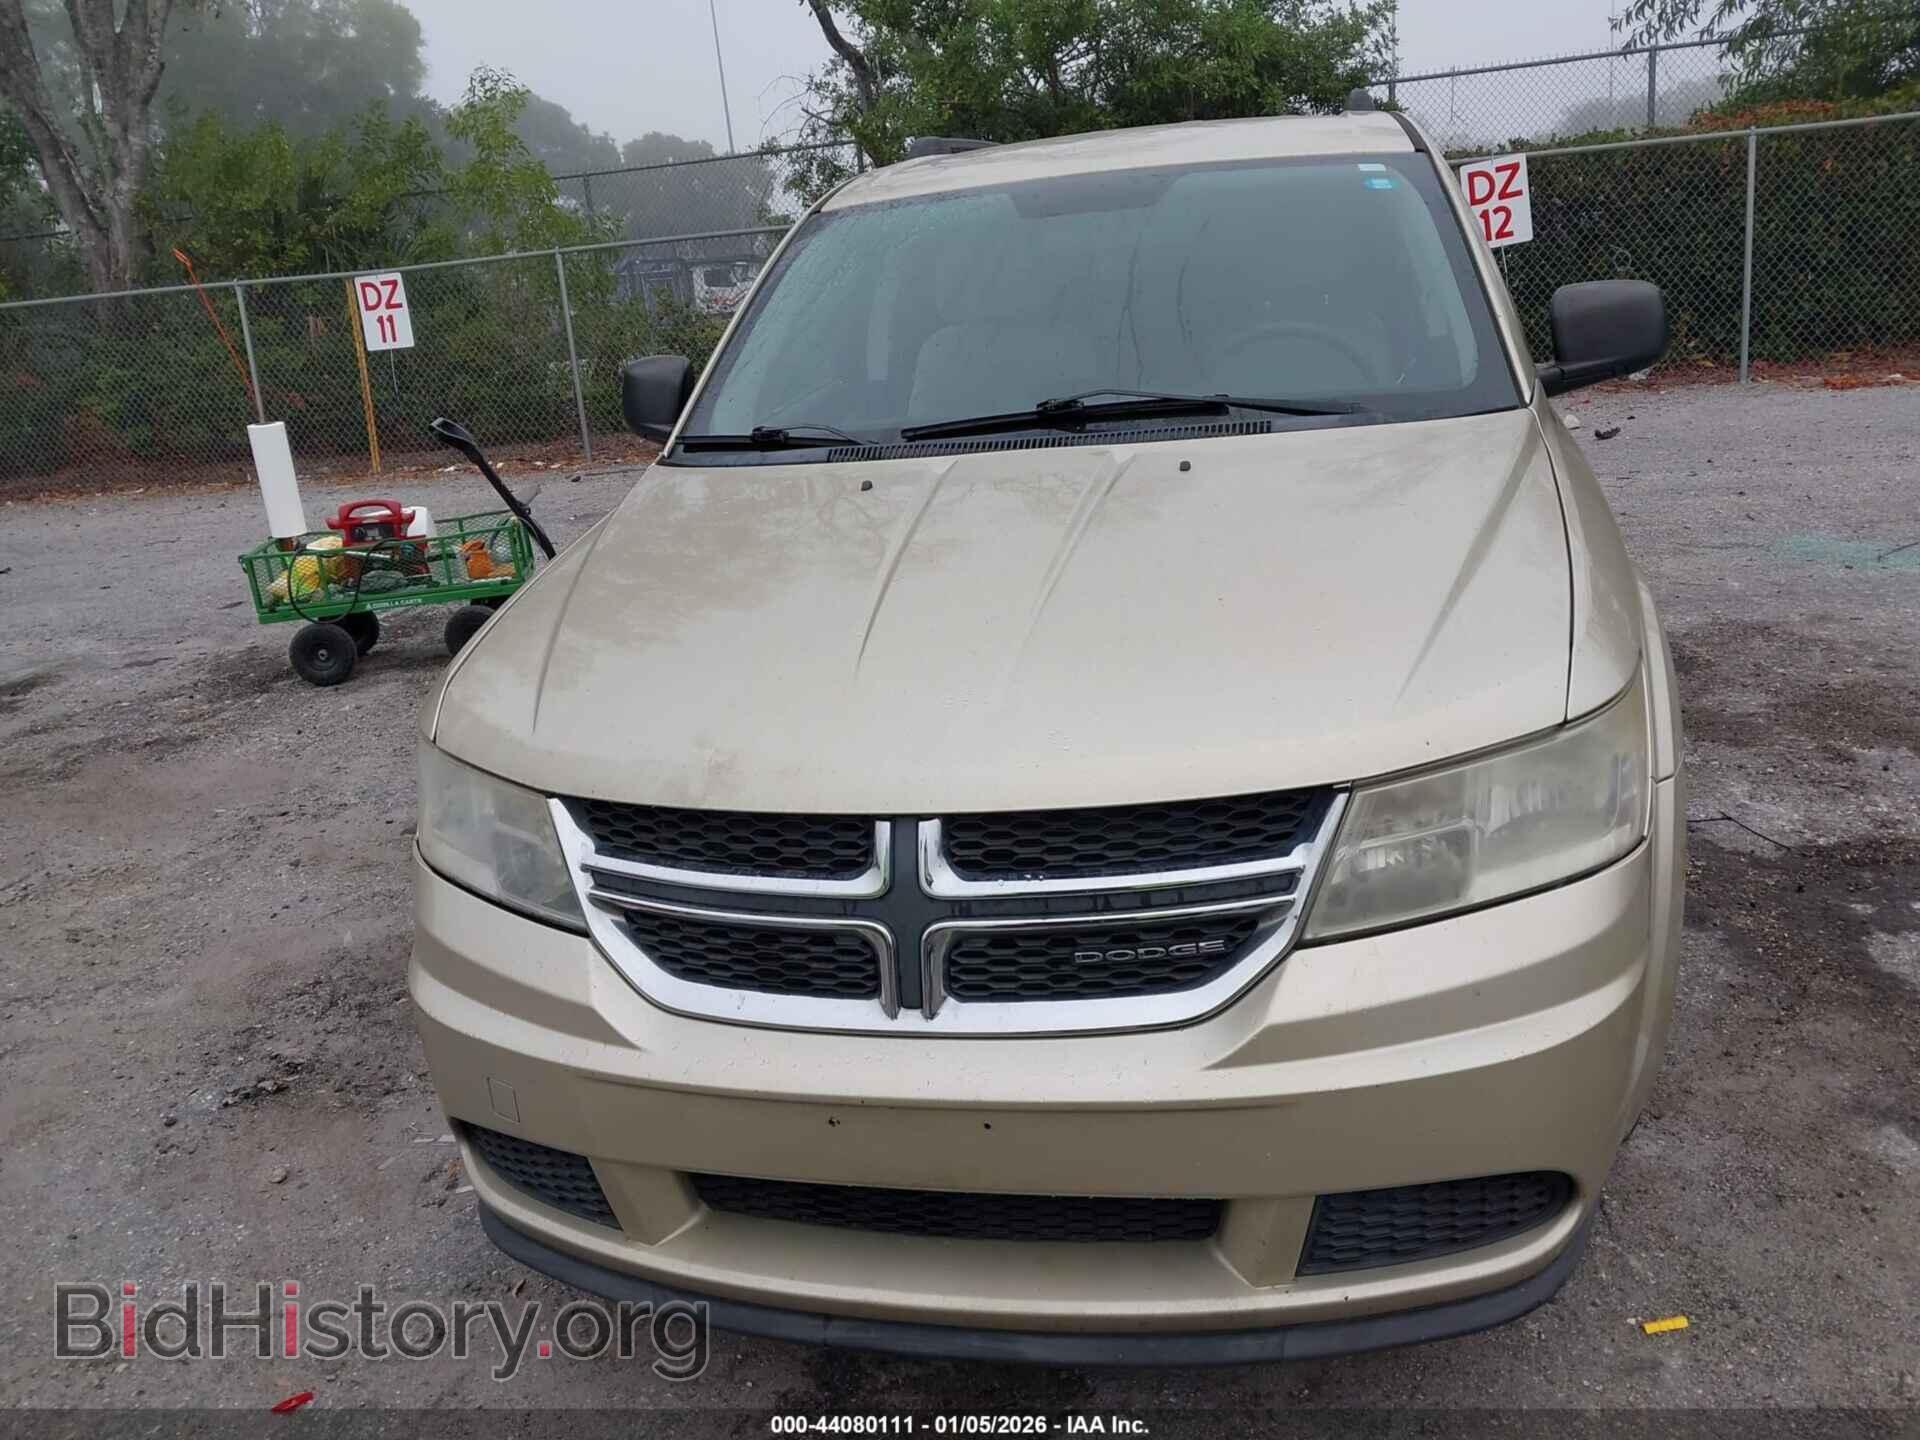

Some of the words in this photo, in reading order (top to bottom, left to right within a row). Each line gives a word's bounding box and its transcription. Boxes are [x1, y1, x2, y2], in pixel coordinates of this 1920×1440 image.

[1467, 162, 1523, 206] DZ
[1479, 206, 1514, 241] 12
[360, 280, 403, 311] DZ
[376, 314, 397, 343] 11
[1074, 940, 1225, 963] DODGE
